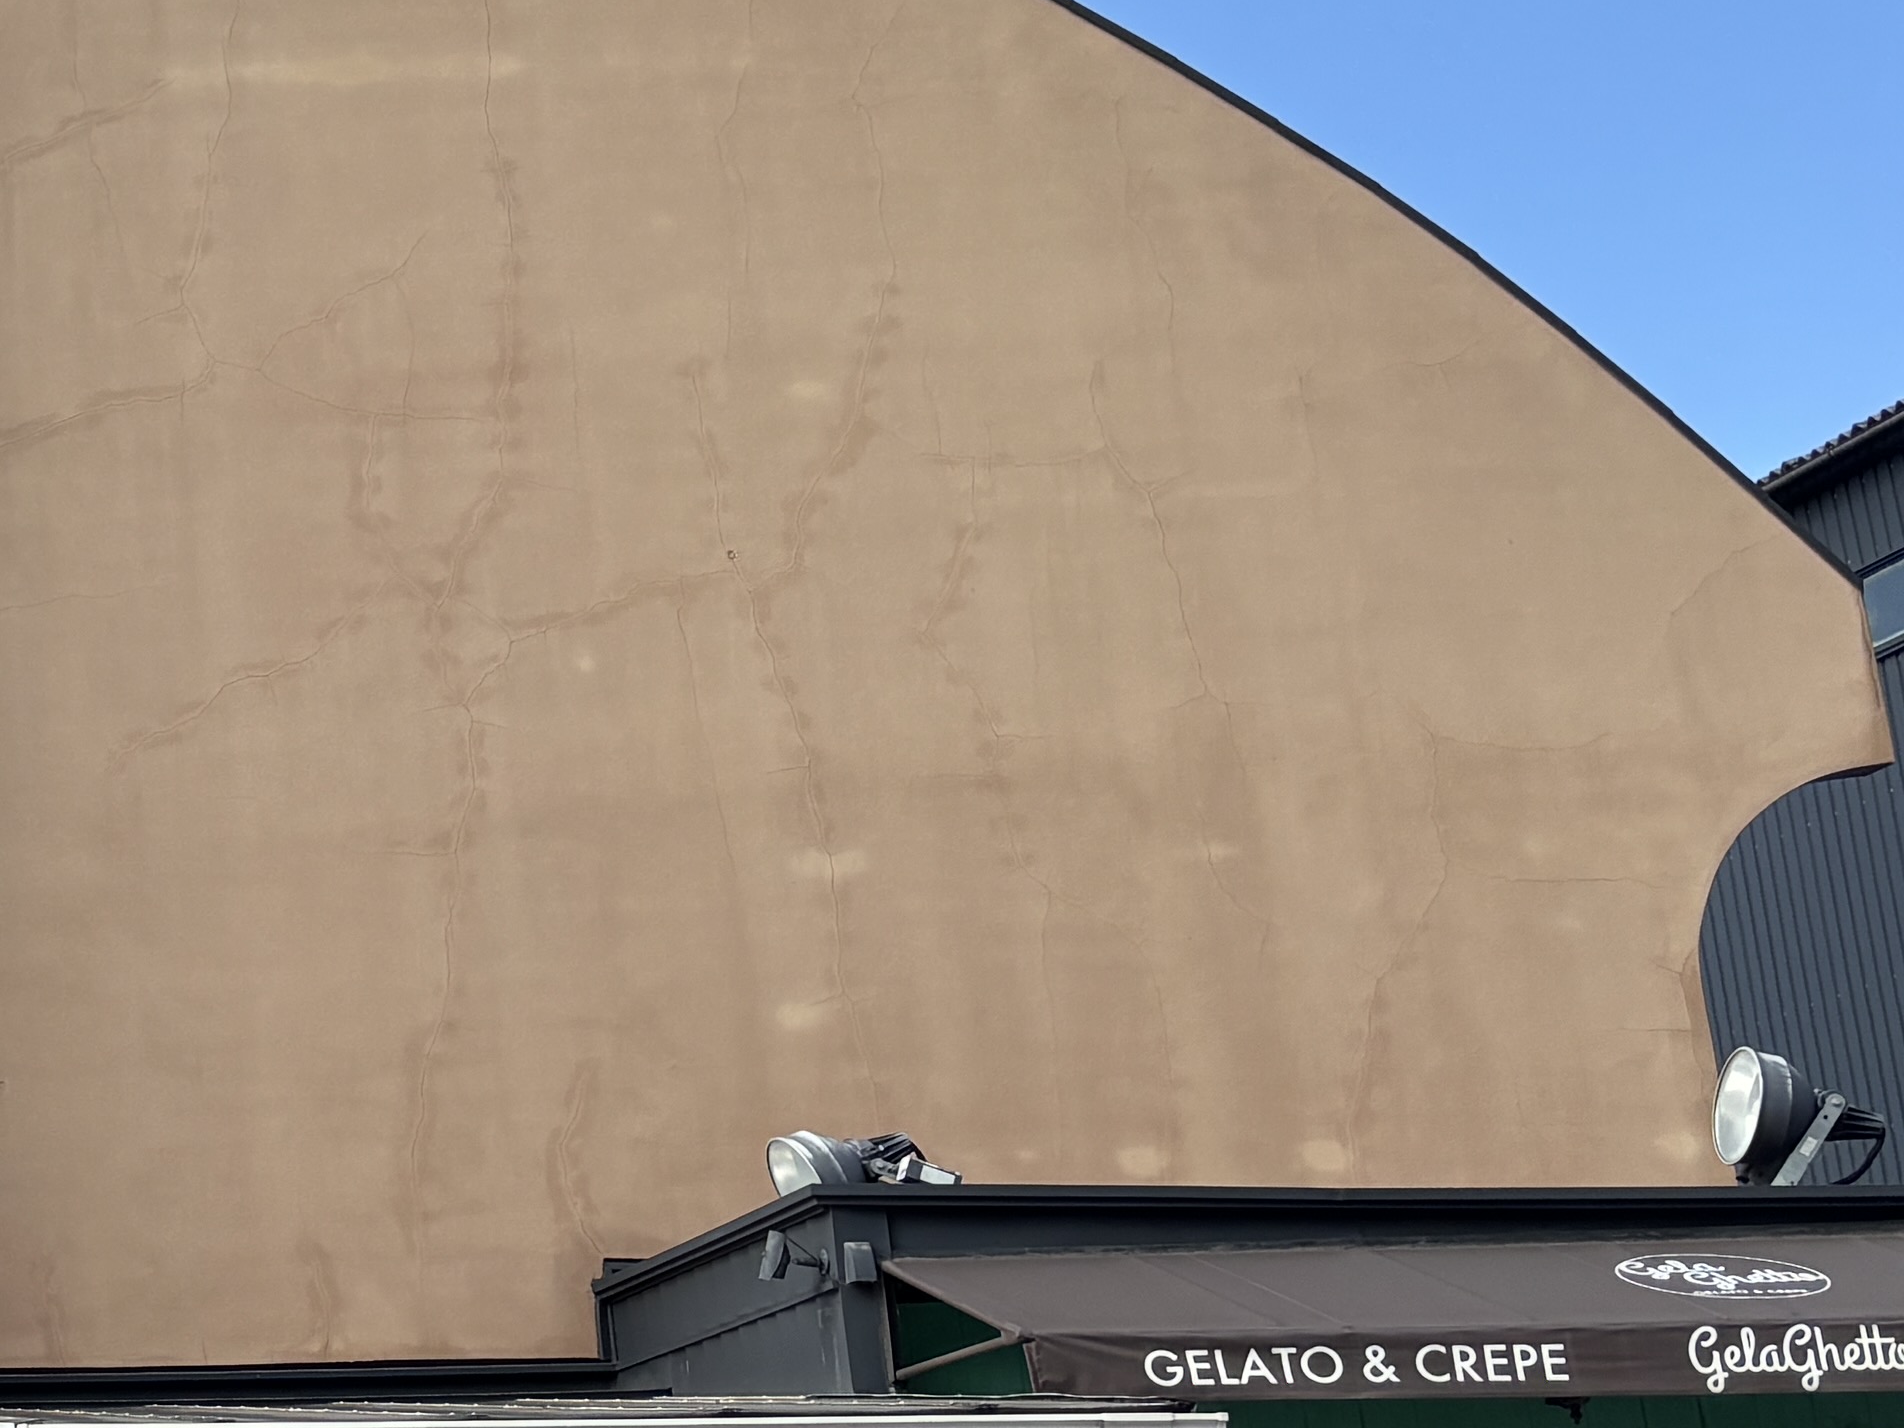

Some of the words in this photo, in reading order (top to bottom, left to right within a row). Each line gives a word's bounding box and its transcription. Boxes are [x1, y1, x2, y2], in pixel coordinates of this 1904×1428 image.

[1143, 1345, 1343, 1387] GELATO
[1362, 1344, 1401, 1383] &
[1415, 1343, 1570, 1383] CREPE
[1688, 1323, 1904, 1394] GelaGhetto
